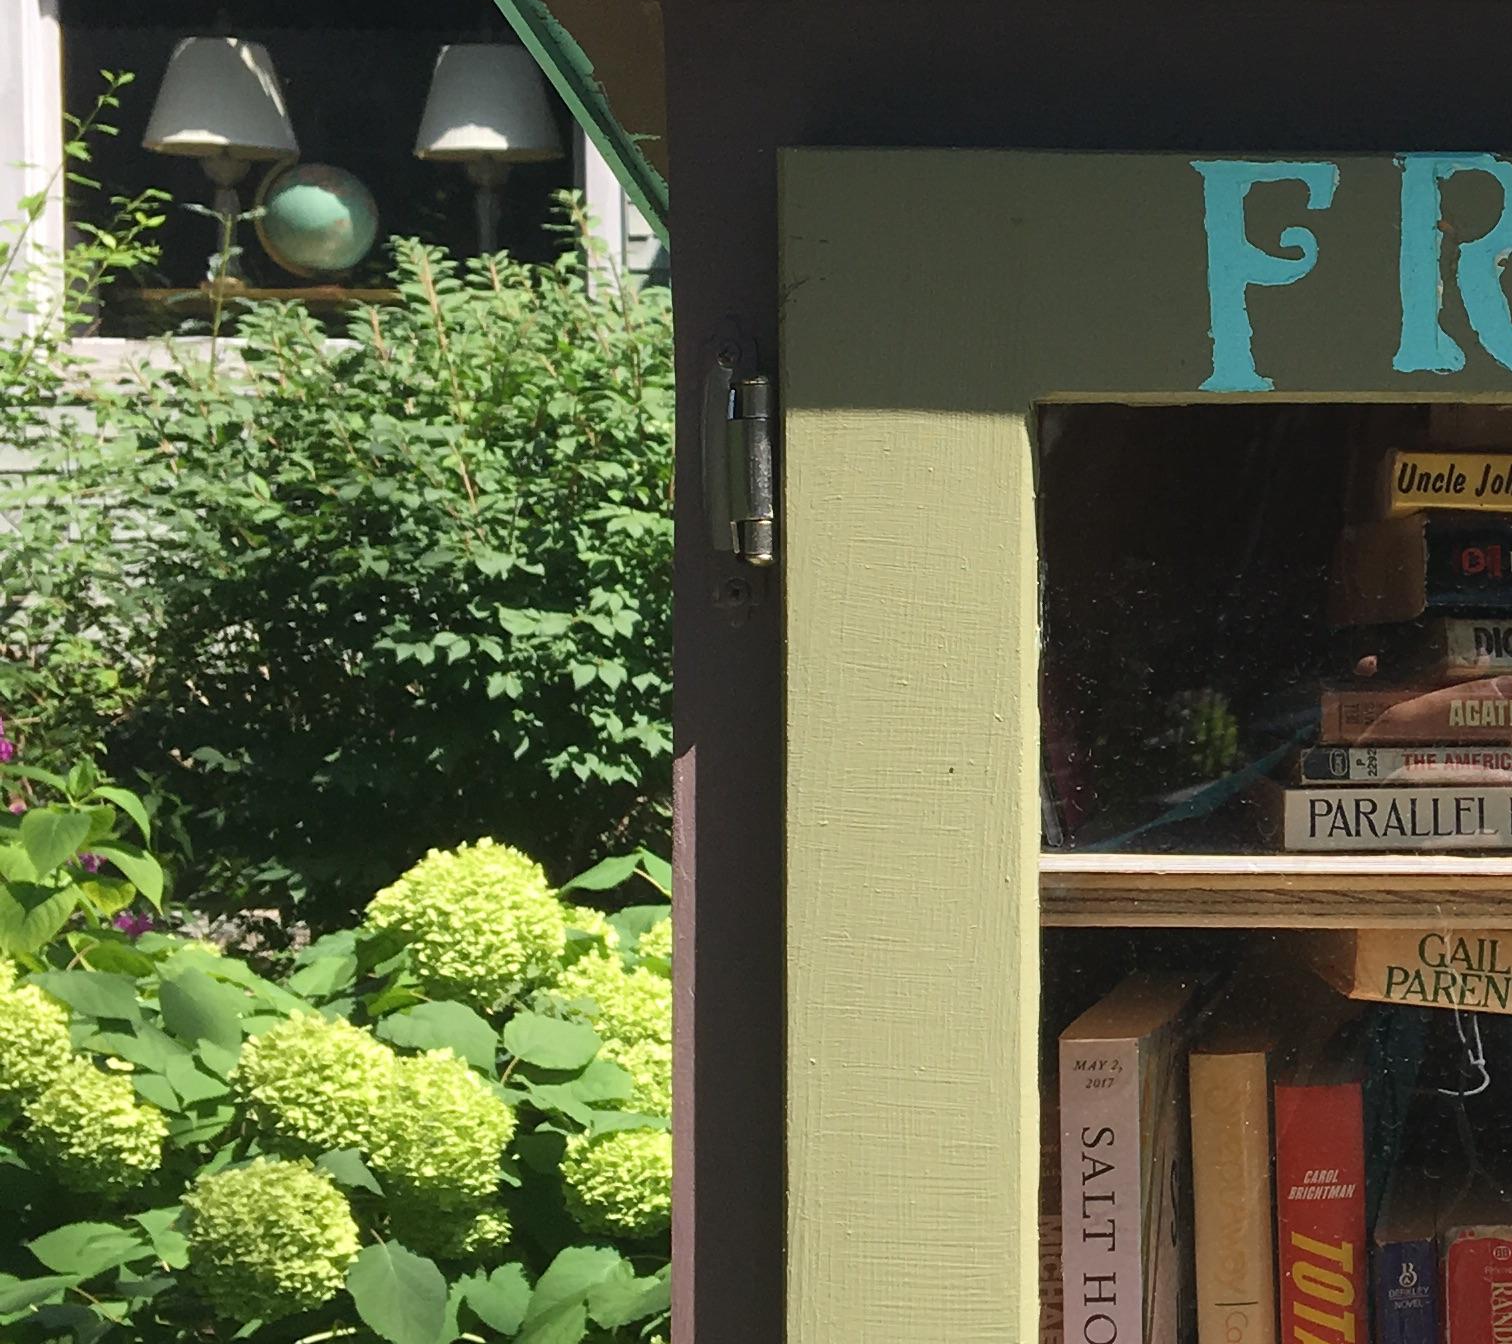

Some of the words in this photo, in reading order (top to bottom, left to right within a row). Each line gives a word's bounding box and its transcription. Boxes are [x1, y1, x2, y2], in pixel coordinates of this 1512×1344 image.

[1397, 462, 1465, 495] Uncle
[1401, 752, 1438, 771] THE
[1308, 797, 1500, 839] PARALLEL
[1417, 931, 1512, 976] GAIL
[1072, 1058, 1108, 1072] MAY
[1110, 1058, 1124, 1073] 2,
[1084, 1076, 1116, 1090] 2017
[1303, 1169, 1340, 1185] CAROL
[1080, 1125, 1116, 1253] SALT
[1287, 1184, 1356, 1201] BRIGHTMAN
